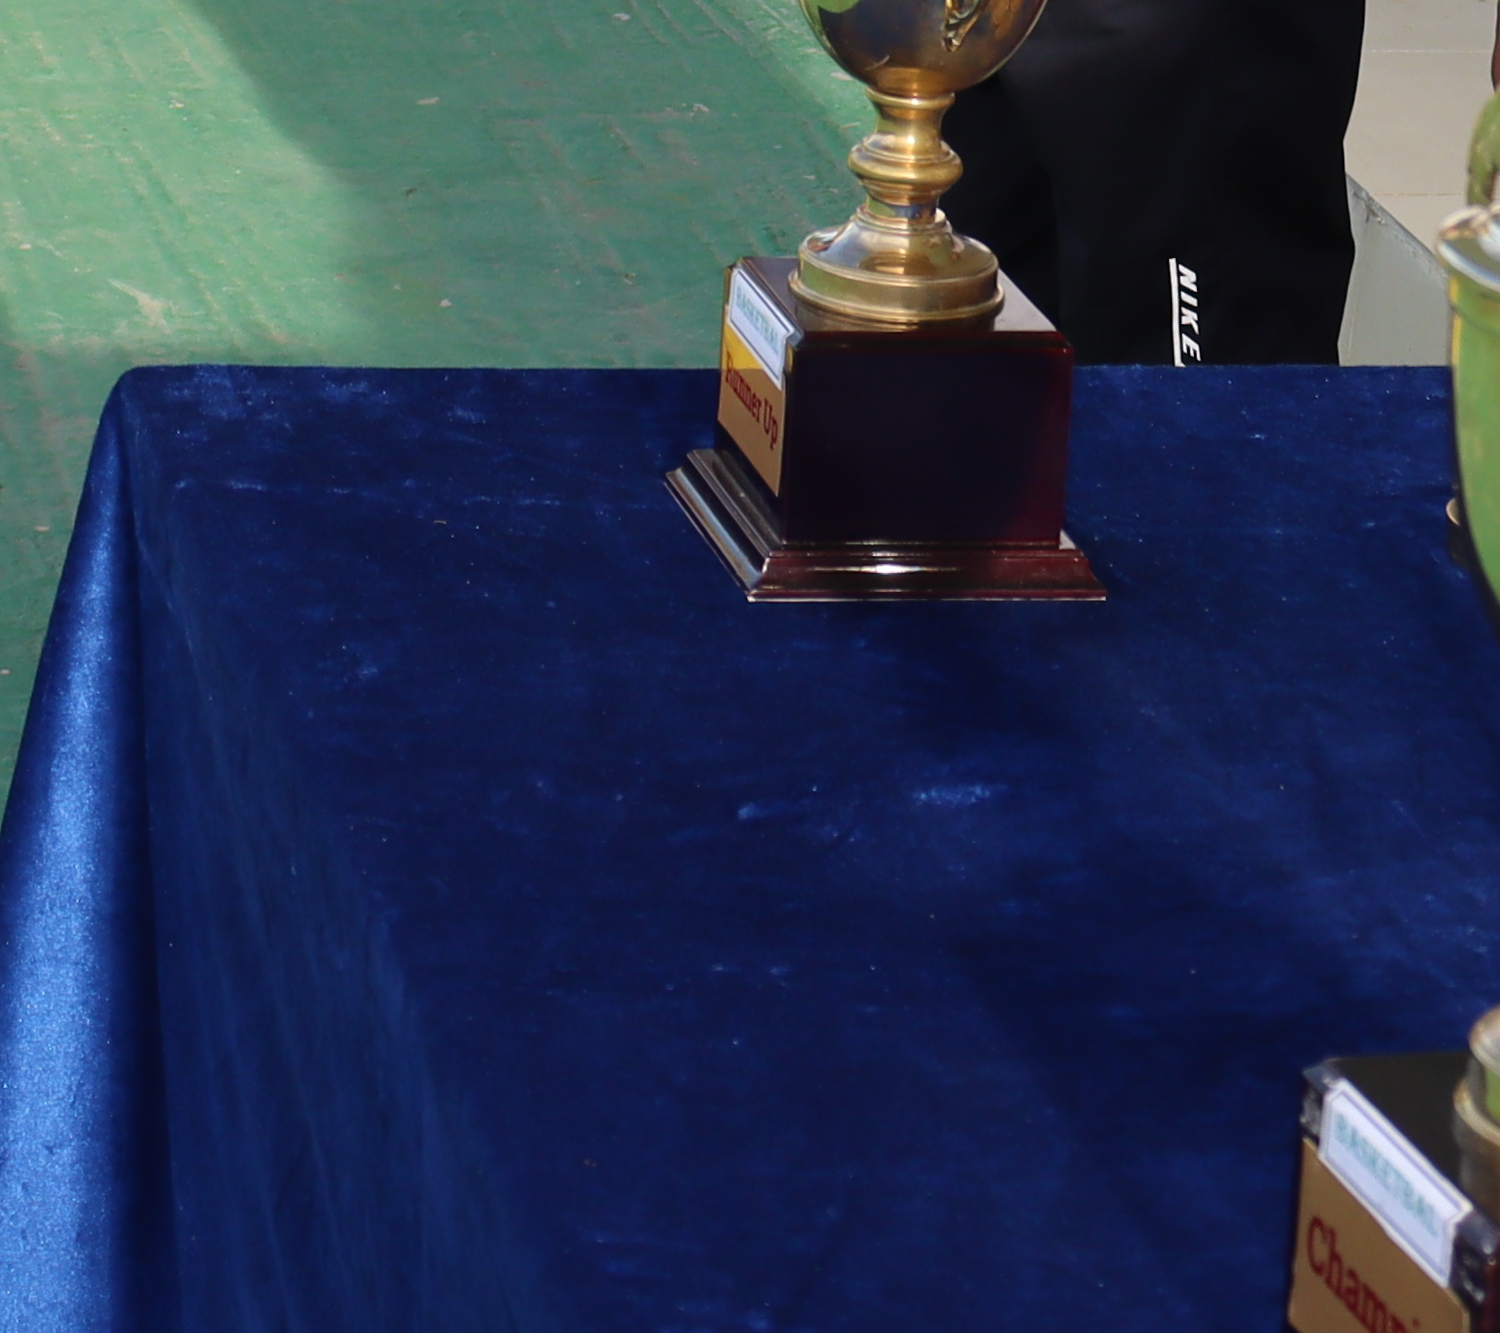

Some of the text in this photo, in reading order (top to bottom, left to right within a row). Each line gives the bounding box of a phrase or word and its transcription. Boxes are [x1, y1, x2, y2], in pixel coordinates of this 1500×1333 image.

[1179, 264, 1201, 361] NIKE
[726, 351, 778, 451] Runner Up
